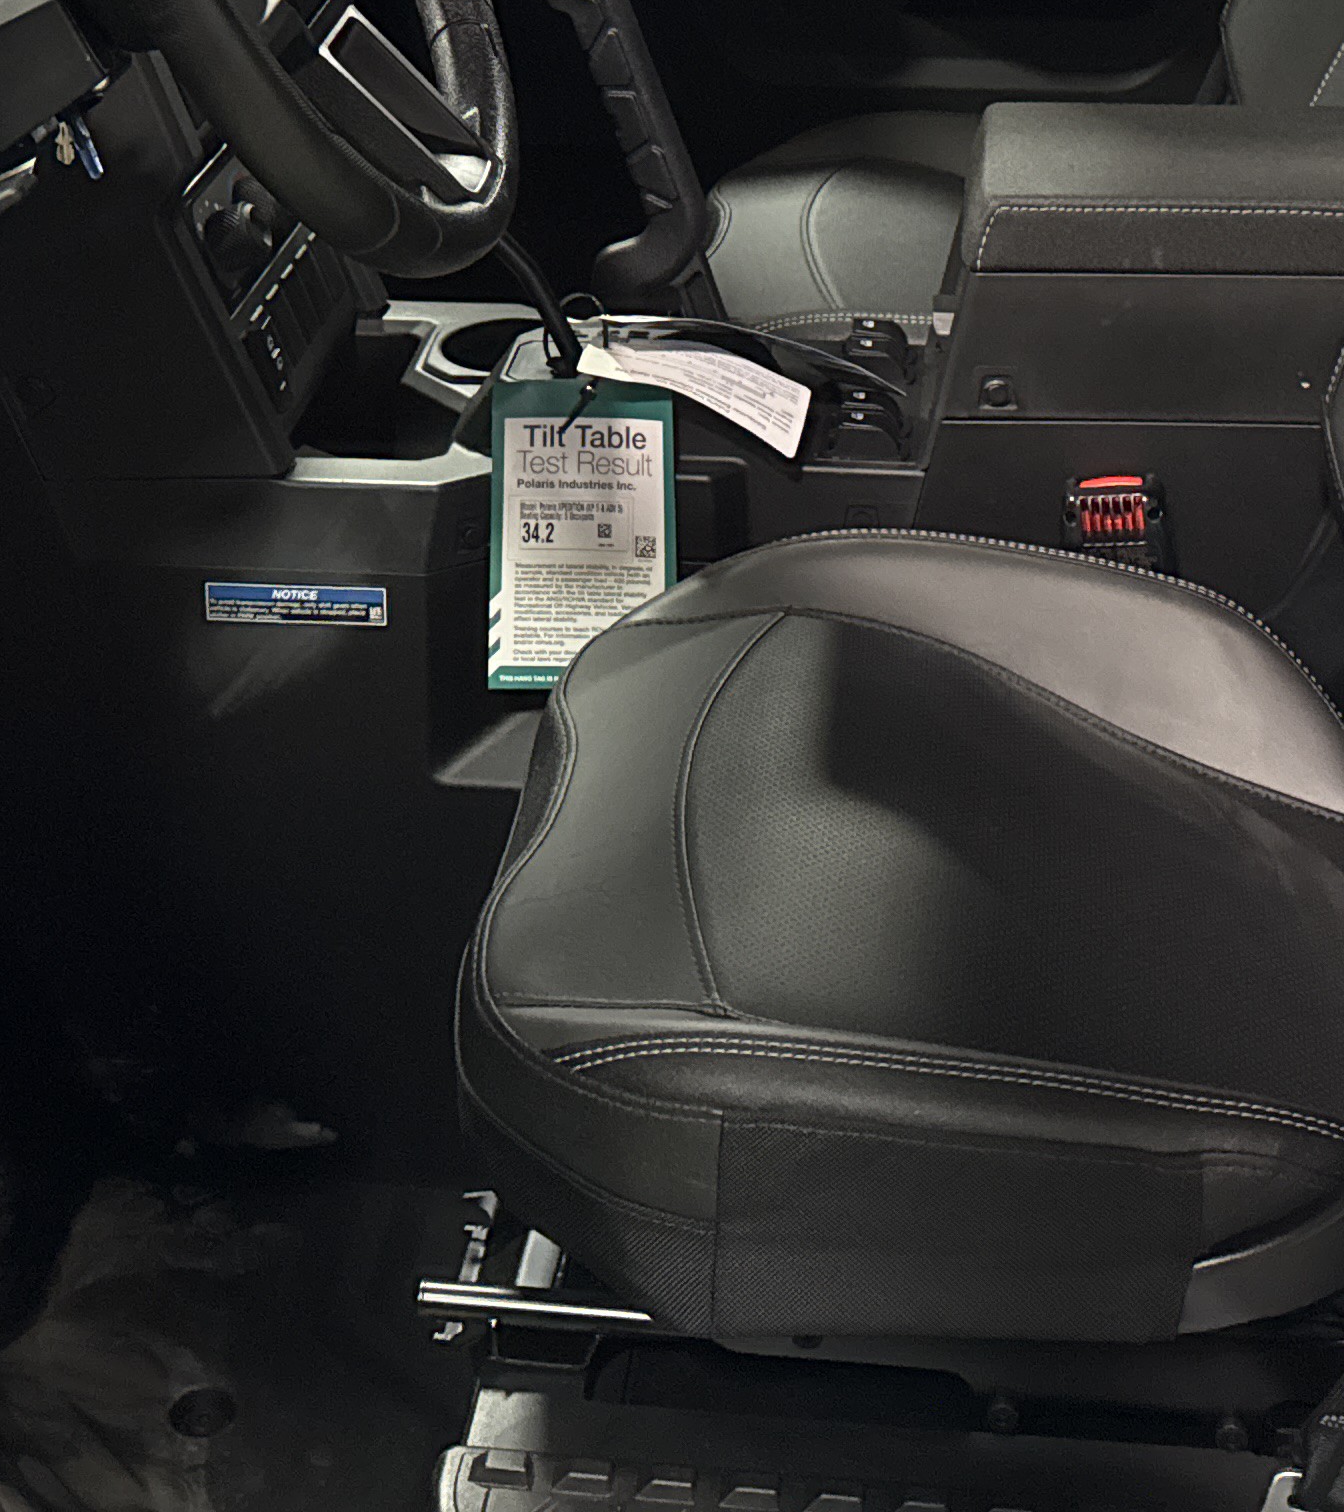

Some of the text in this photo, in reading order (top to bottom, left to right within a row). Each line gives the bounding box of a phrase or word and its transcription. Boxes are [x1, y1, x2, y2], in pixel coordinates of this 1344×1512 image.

[523, 424, 647, 450] Tilt Table
[516, 449, 653, 478] Test Result
[517, 478, 637, 492] Polaris Industries Inc.
[522, 522, 555, 544] 34.2
[271, 589, 319, 600] NOTICE
